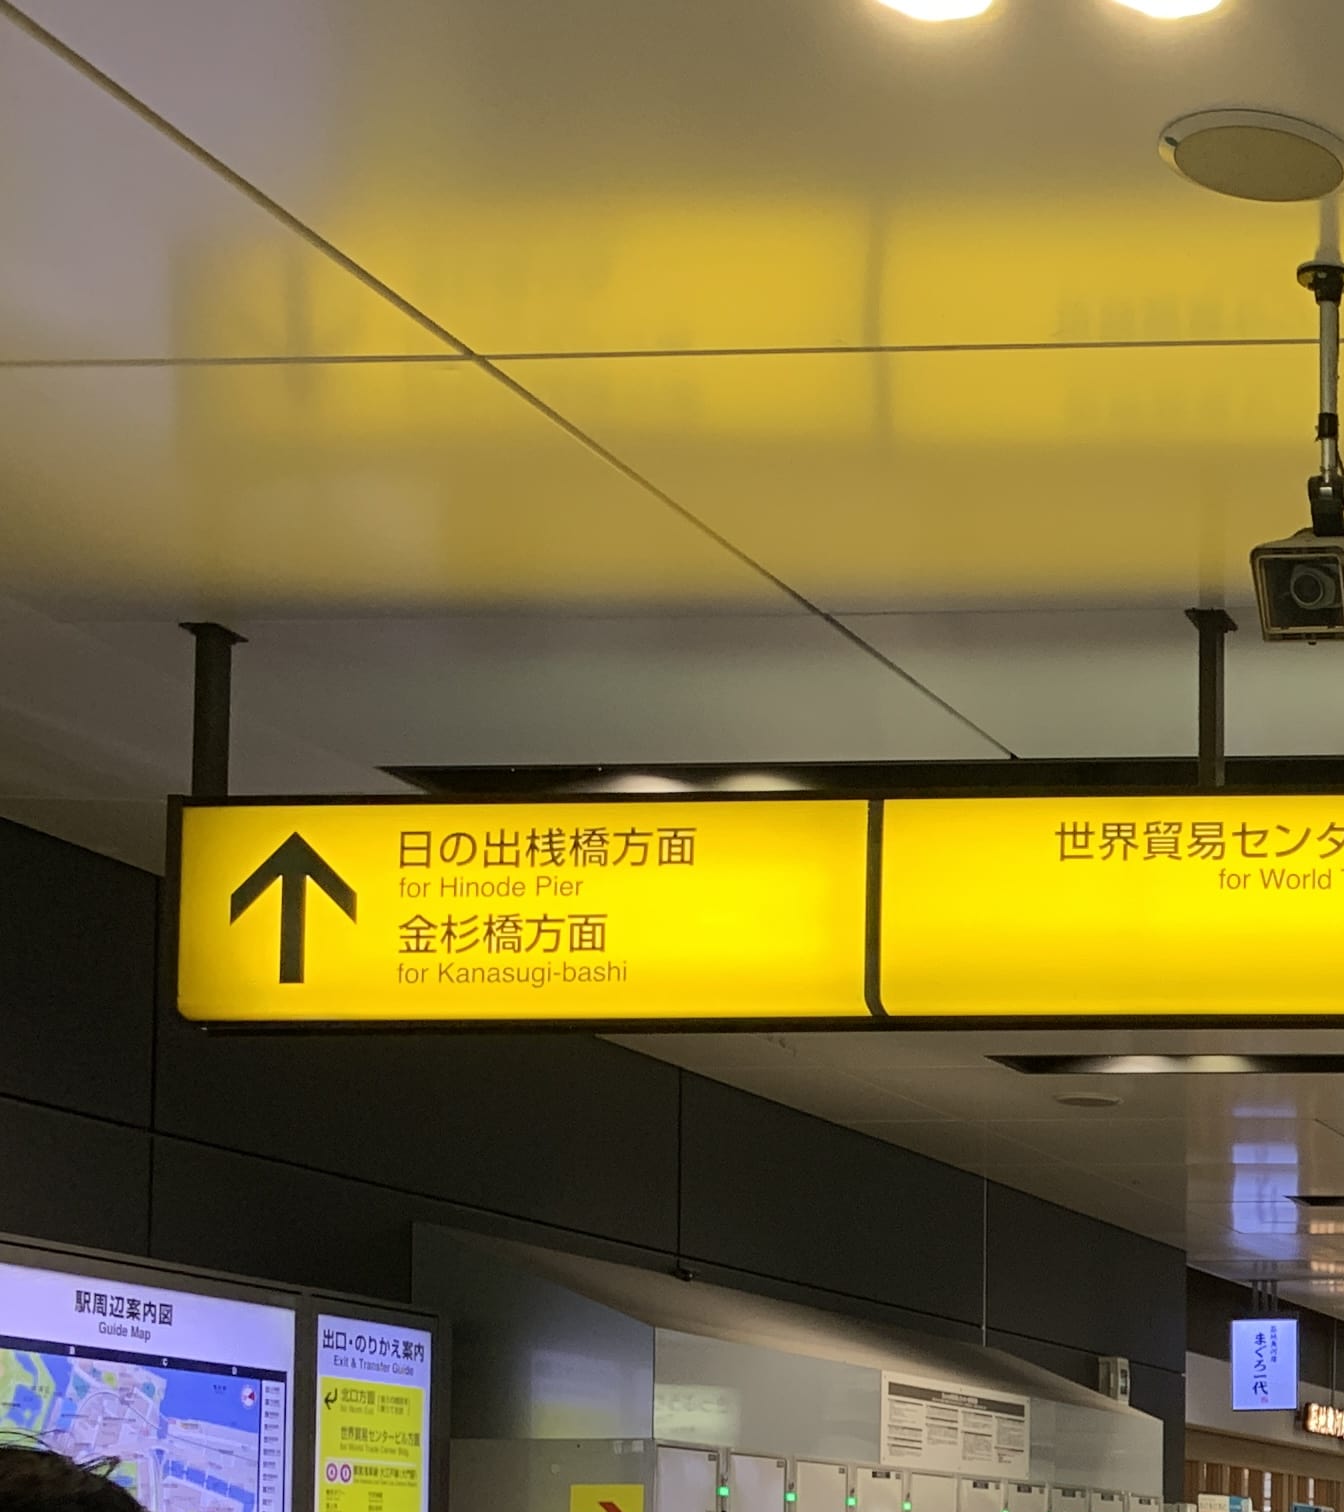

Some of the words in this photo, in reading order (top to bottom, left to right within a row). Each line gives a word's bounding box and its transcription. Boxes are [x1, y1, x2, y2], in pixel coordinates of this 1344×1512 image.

[399, 827, 697, 869] 日の出桟橋方面
[400, 877, 430, 898] for
[440, 876, 526, 897] Hinode
[536, 875, 584, 897] Pier
[1219, 868, 1250, 890] for
[1260, 868, 1332, 890] World
[398, 913, 608, 954] 金杉橋方面
[398, 963, 429, 984] for
[439, 960, 628, 988] Kanasugi-bashi
[75, 1290, 173, 1326] 駅周辺案内図
[98, 1321, 128, 1338] Guide
[130, 1325, 151, 1342] Map
[322, 1328, 425, 1363] 出口・のりかえ案内
[333, 1355, 350, 1368] Exit
[351, 1358, 356, 1368] &
[359, 1360, 390, 1374] Transfer
[392, 1362, 414, 1377] Guide
[1252, 1332, 1269, 1395] まぐろ一代
